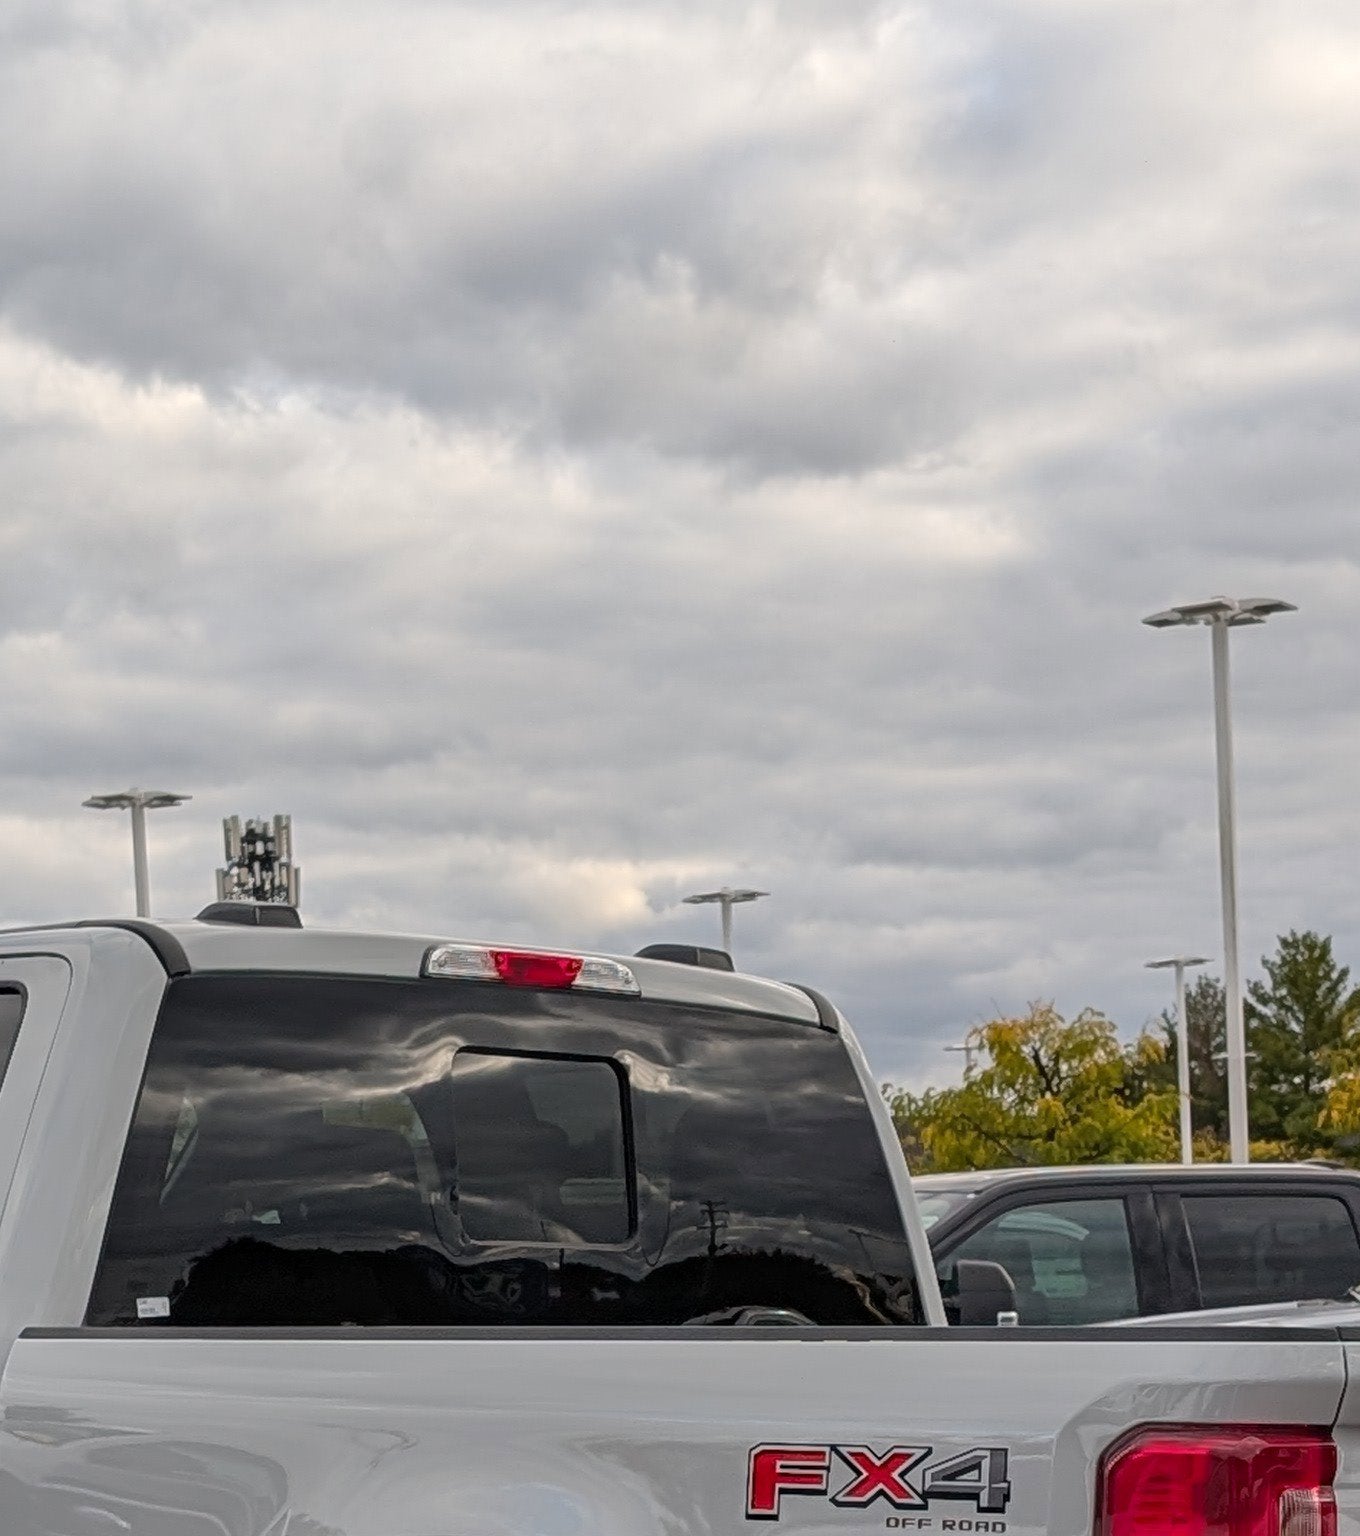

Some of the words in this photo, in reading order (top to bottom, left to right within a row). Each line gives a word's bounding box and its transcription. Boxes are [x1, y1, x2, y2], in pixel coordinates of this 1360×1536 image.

[745, 1442, 1011, 1521] FX4
[886, 1516, 932, 1530] OFF
[942, 1519, 1007, 1534] ROAD
